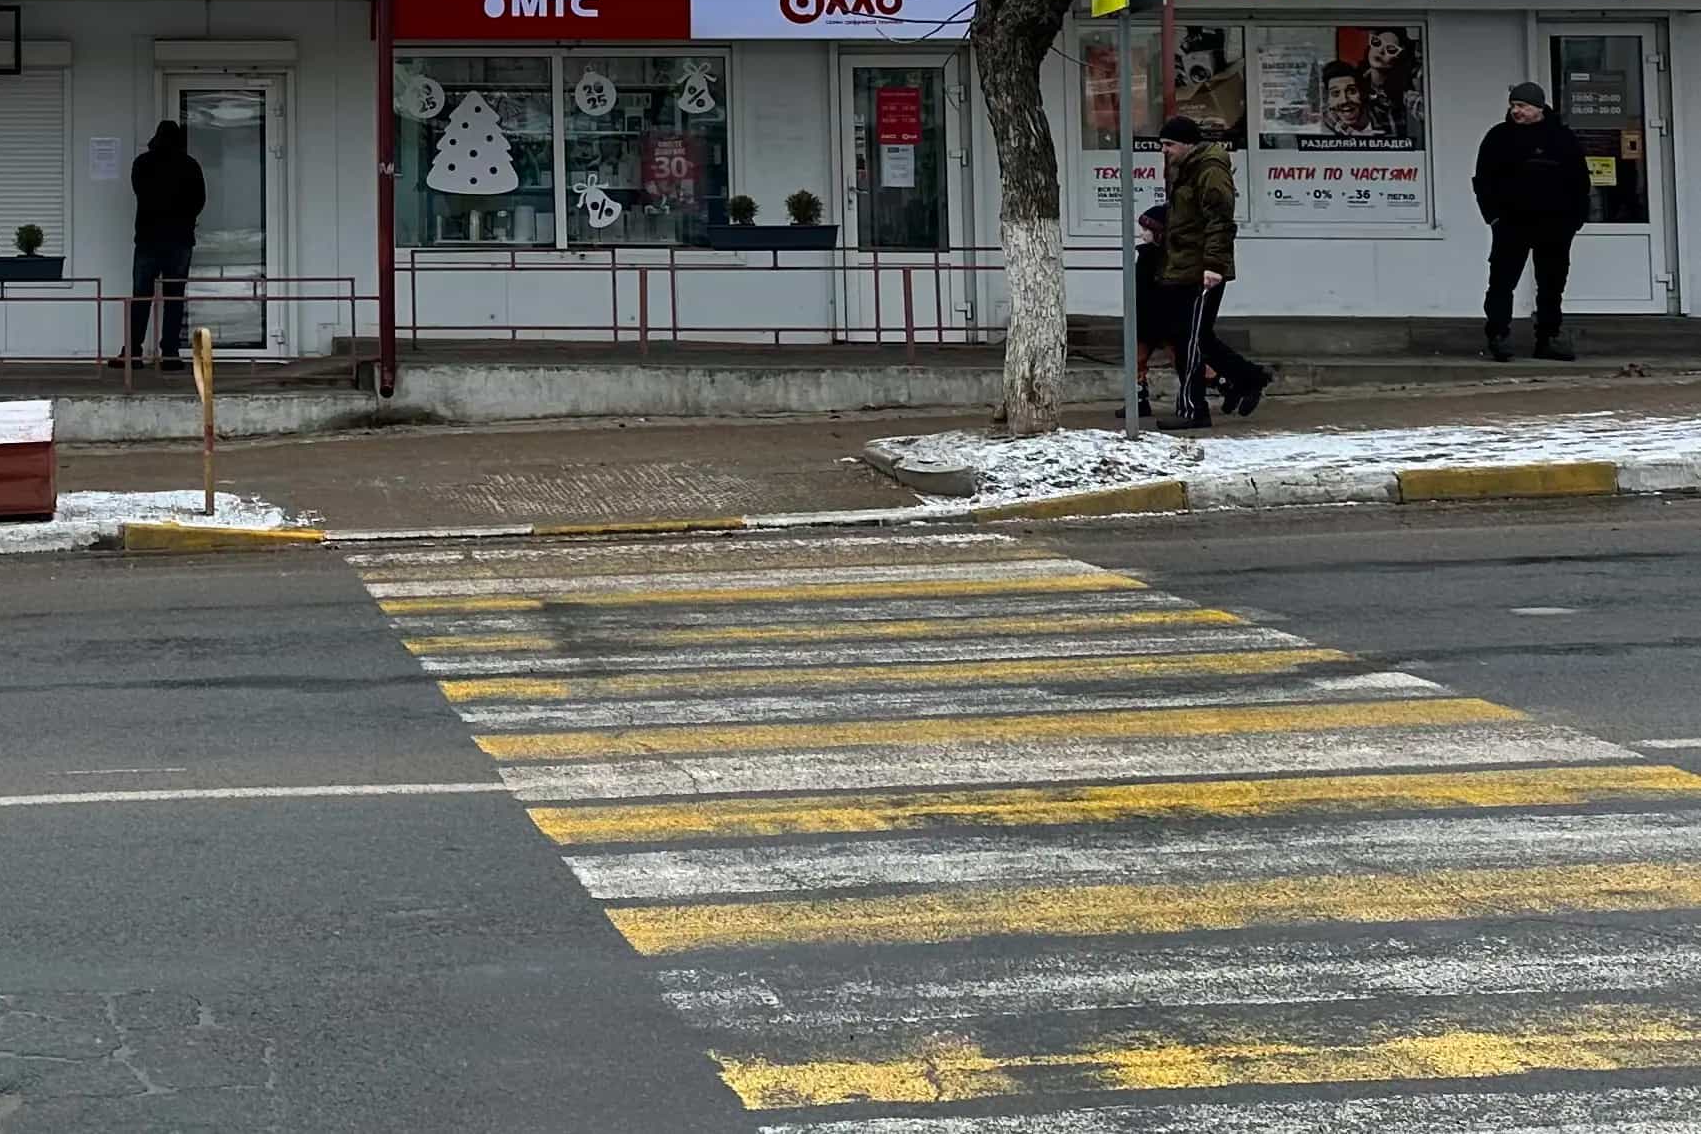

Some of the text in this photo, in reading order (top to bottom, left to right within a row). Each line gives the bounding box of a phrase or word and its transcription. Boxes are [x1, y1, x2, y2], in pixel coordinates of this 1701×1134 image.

[1300, 137, 1413, 150] РАЗДЕЛЯЙ И ВЛАДЕЙ
[1093, 167, 1156, 180] ТЕХКА
[1267, 167, 1418, 181] ПЛАТИ ПО ЧАСТЯМ!
